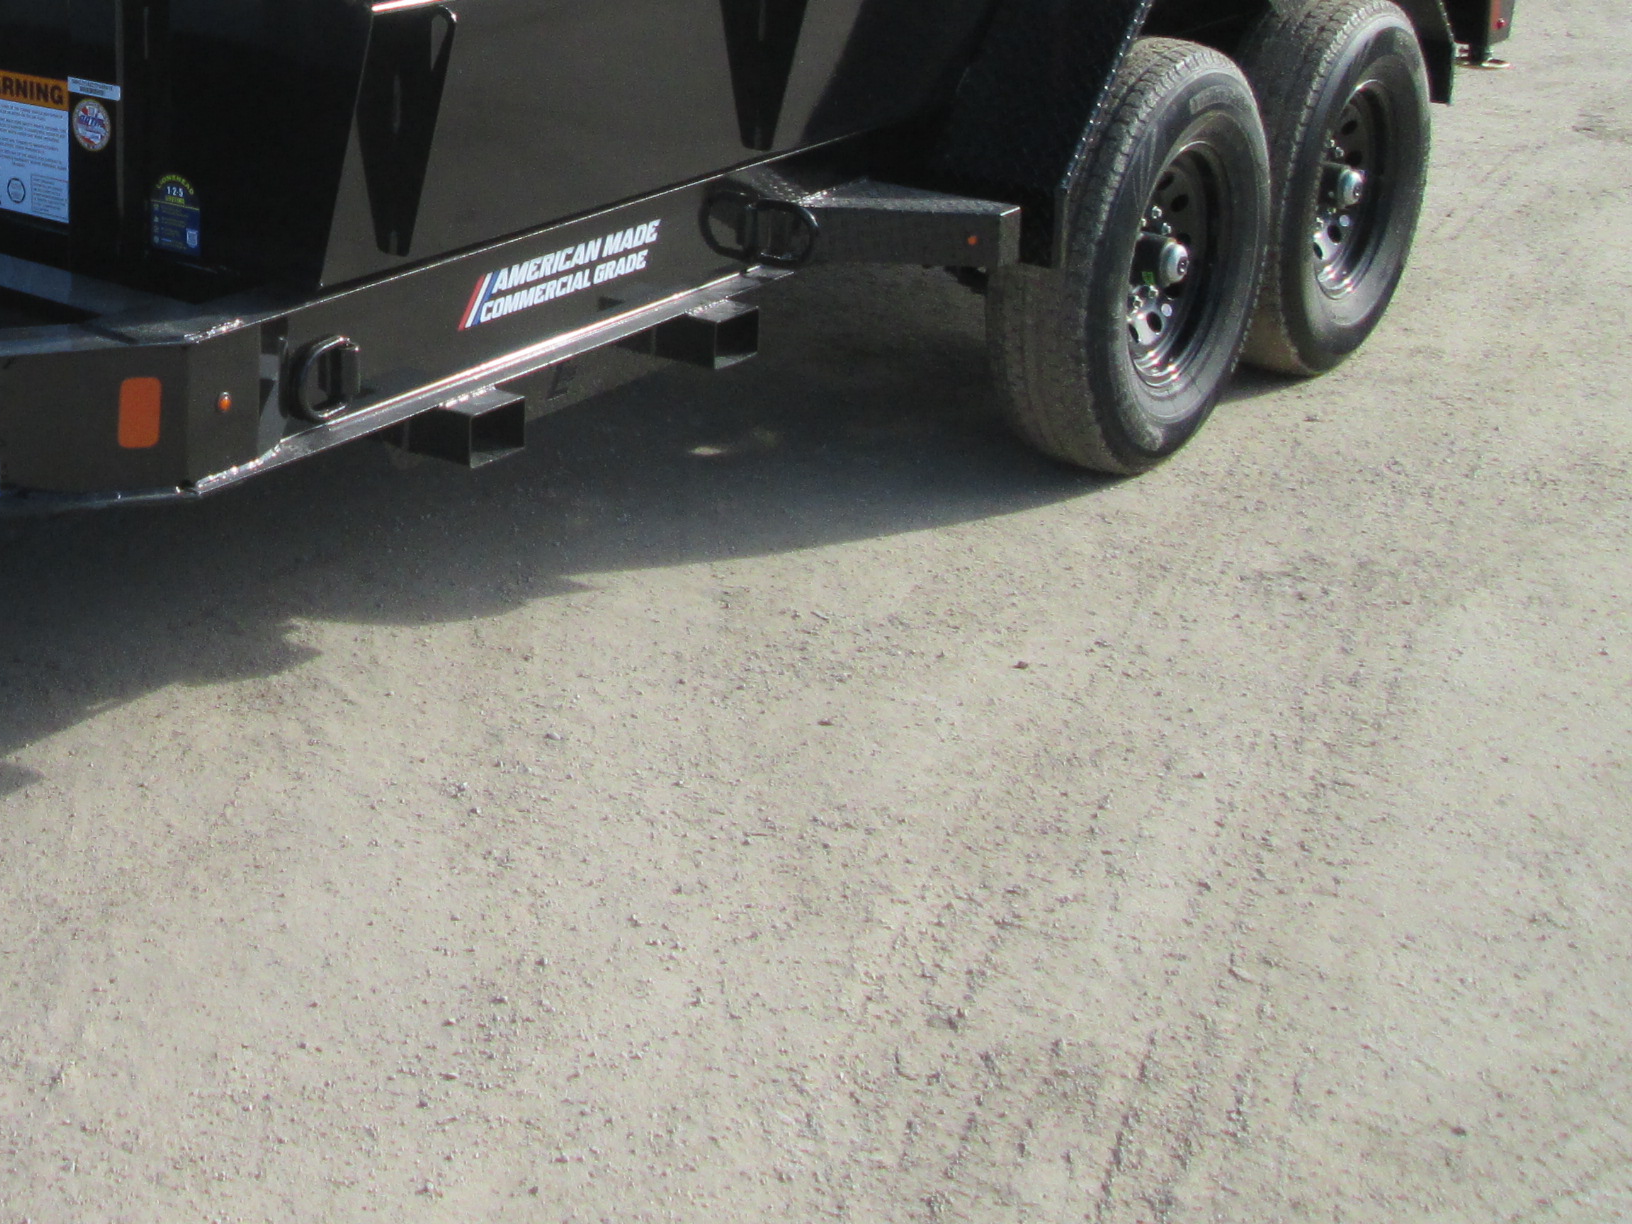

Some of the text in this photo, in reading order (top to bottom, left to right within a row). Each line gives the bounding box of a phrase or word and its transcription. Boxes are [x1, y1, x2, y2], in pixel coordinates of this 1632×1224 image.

[480, 249, 649, 324] COMMERCIAL GRADE
[491, 218, 662, 295] AMERICAN MADE
